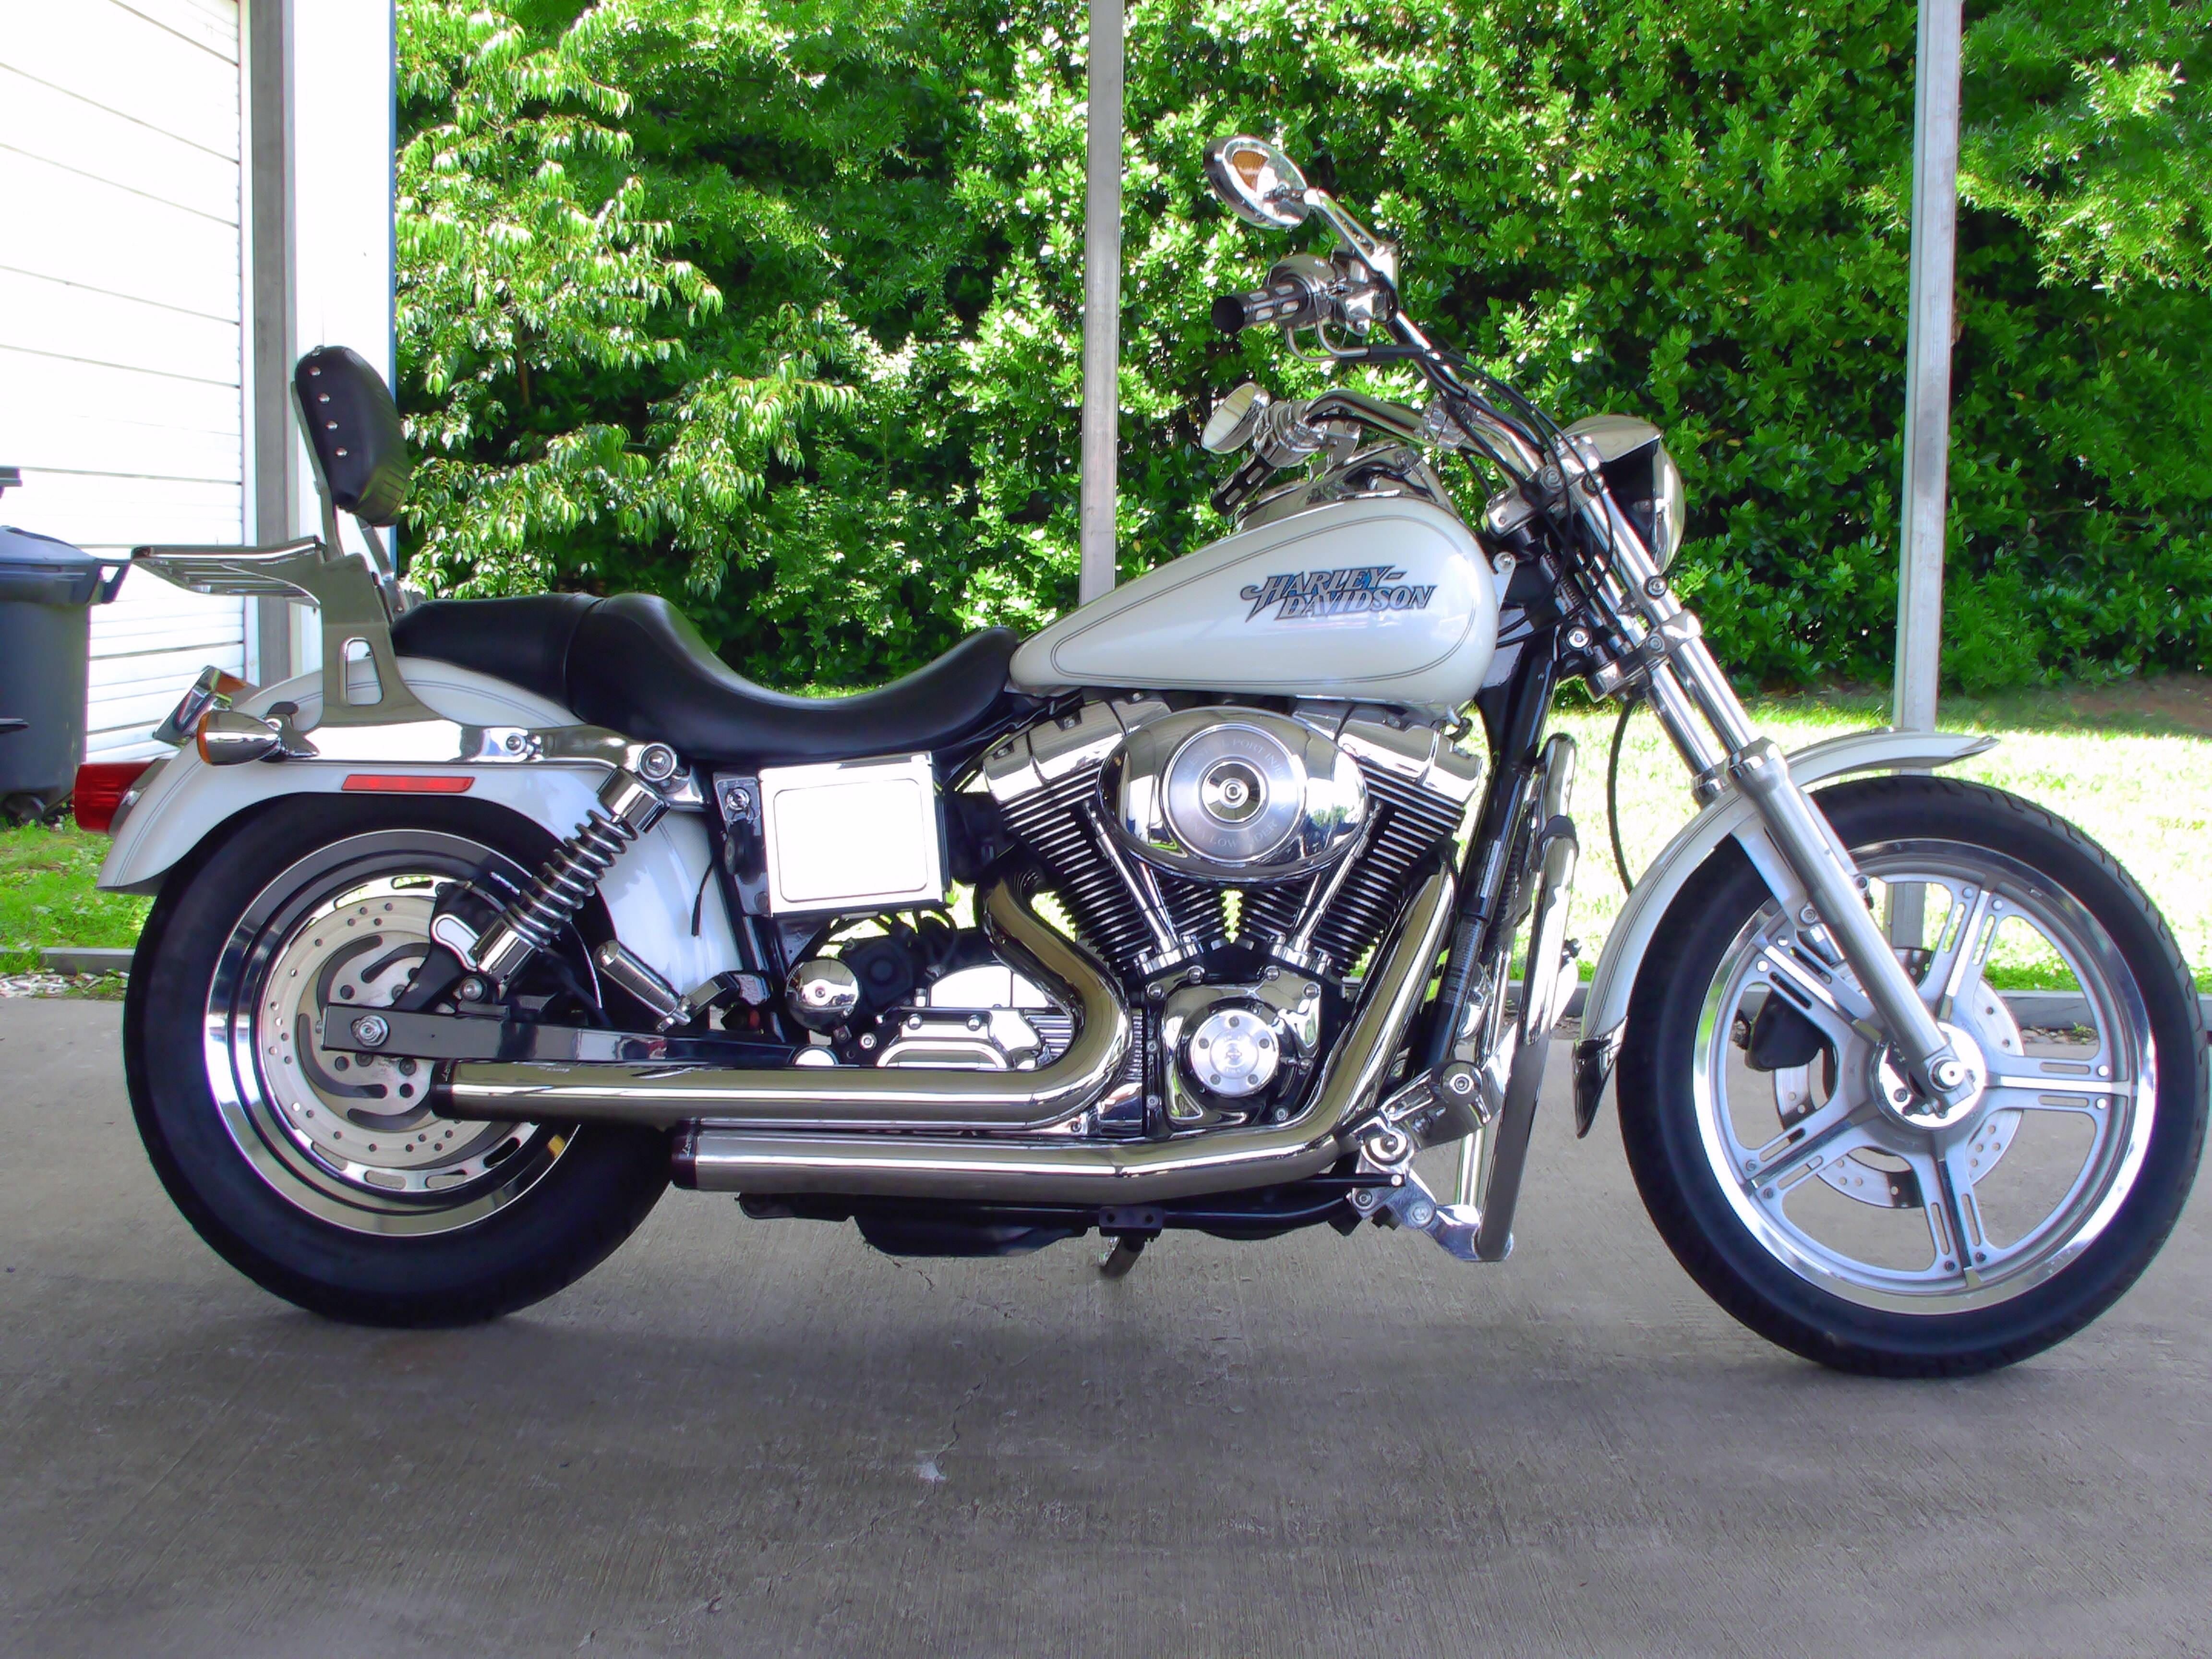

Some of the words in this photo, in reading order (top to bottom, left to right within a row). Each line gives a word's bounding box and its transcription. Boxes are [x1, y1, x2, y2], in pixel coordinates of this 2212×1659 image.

[1273, 585, 1438, 621] DAVIDSON
[1233, 738, 1263, 754] PORT
[1209, 836, 1237, 848] LOW
[1245, 818, 1277, 848] IDER
